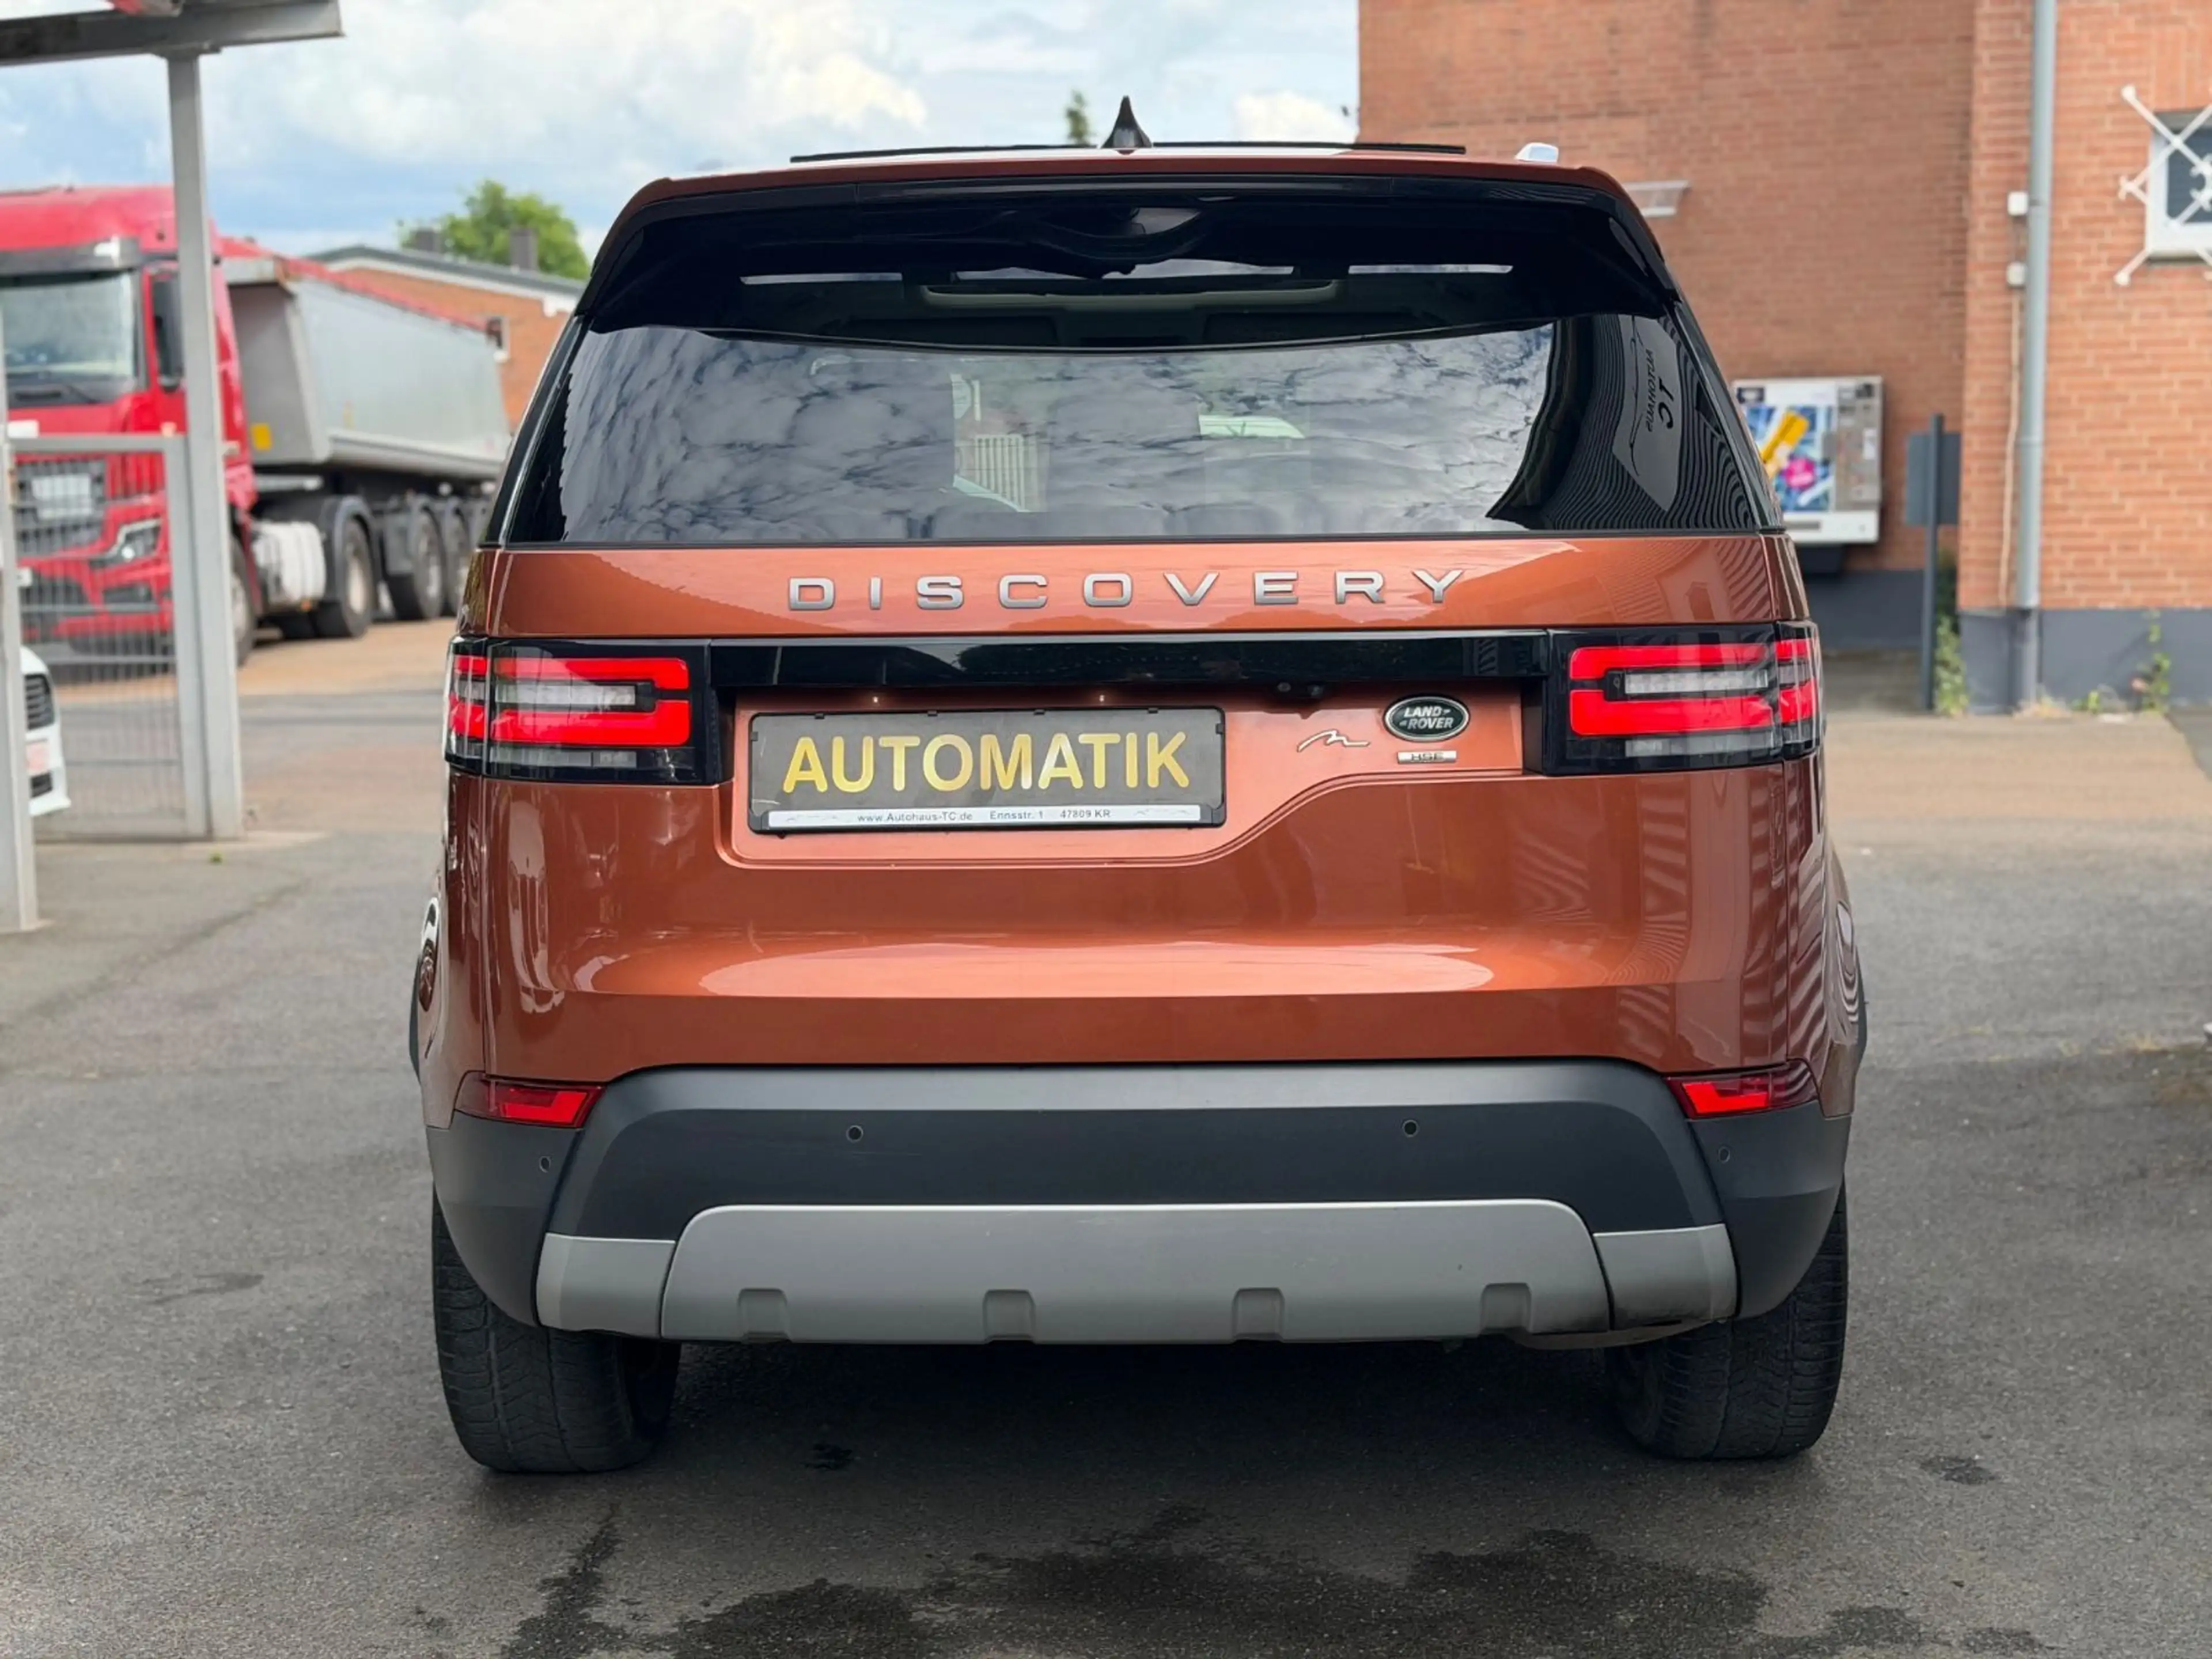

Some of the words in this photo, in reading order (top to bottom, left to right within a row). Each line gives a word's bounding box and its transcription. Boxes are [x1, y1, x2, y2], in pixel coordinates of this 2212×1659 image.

[787, 569, 1464, 611] DISCOVERY
[1404, 706, 1443, 718] LAND
[1407, 717, 1453, 730] ROVER
[782, 732, 1190, 794] AUTOMATIK
[1411, 752, 1444, 762] HSE
[857, 811, 974, 822] www.Autohaus-TC.de
[1039, 810, 1044, 819] 1
[1060, 809, 1092, 819] 47809
[1094, 809, 1111, 819] KR
